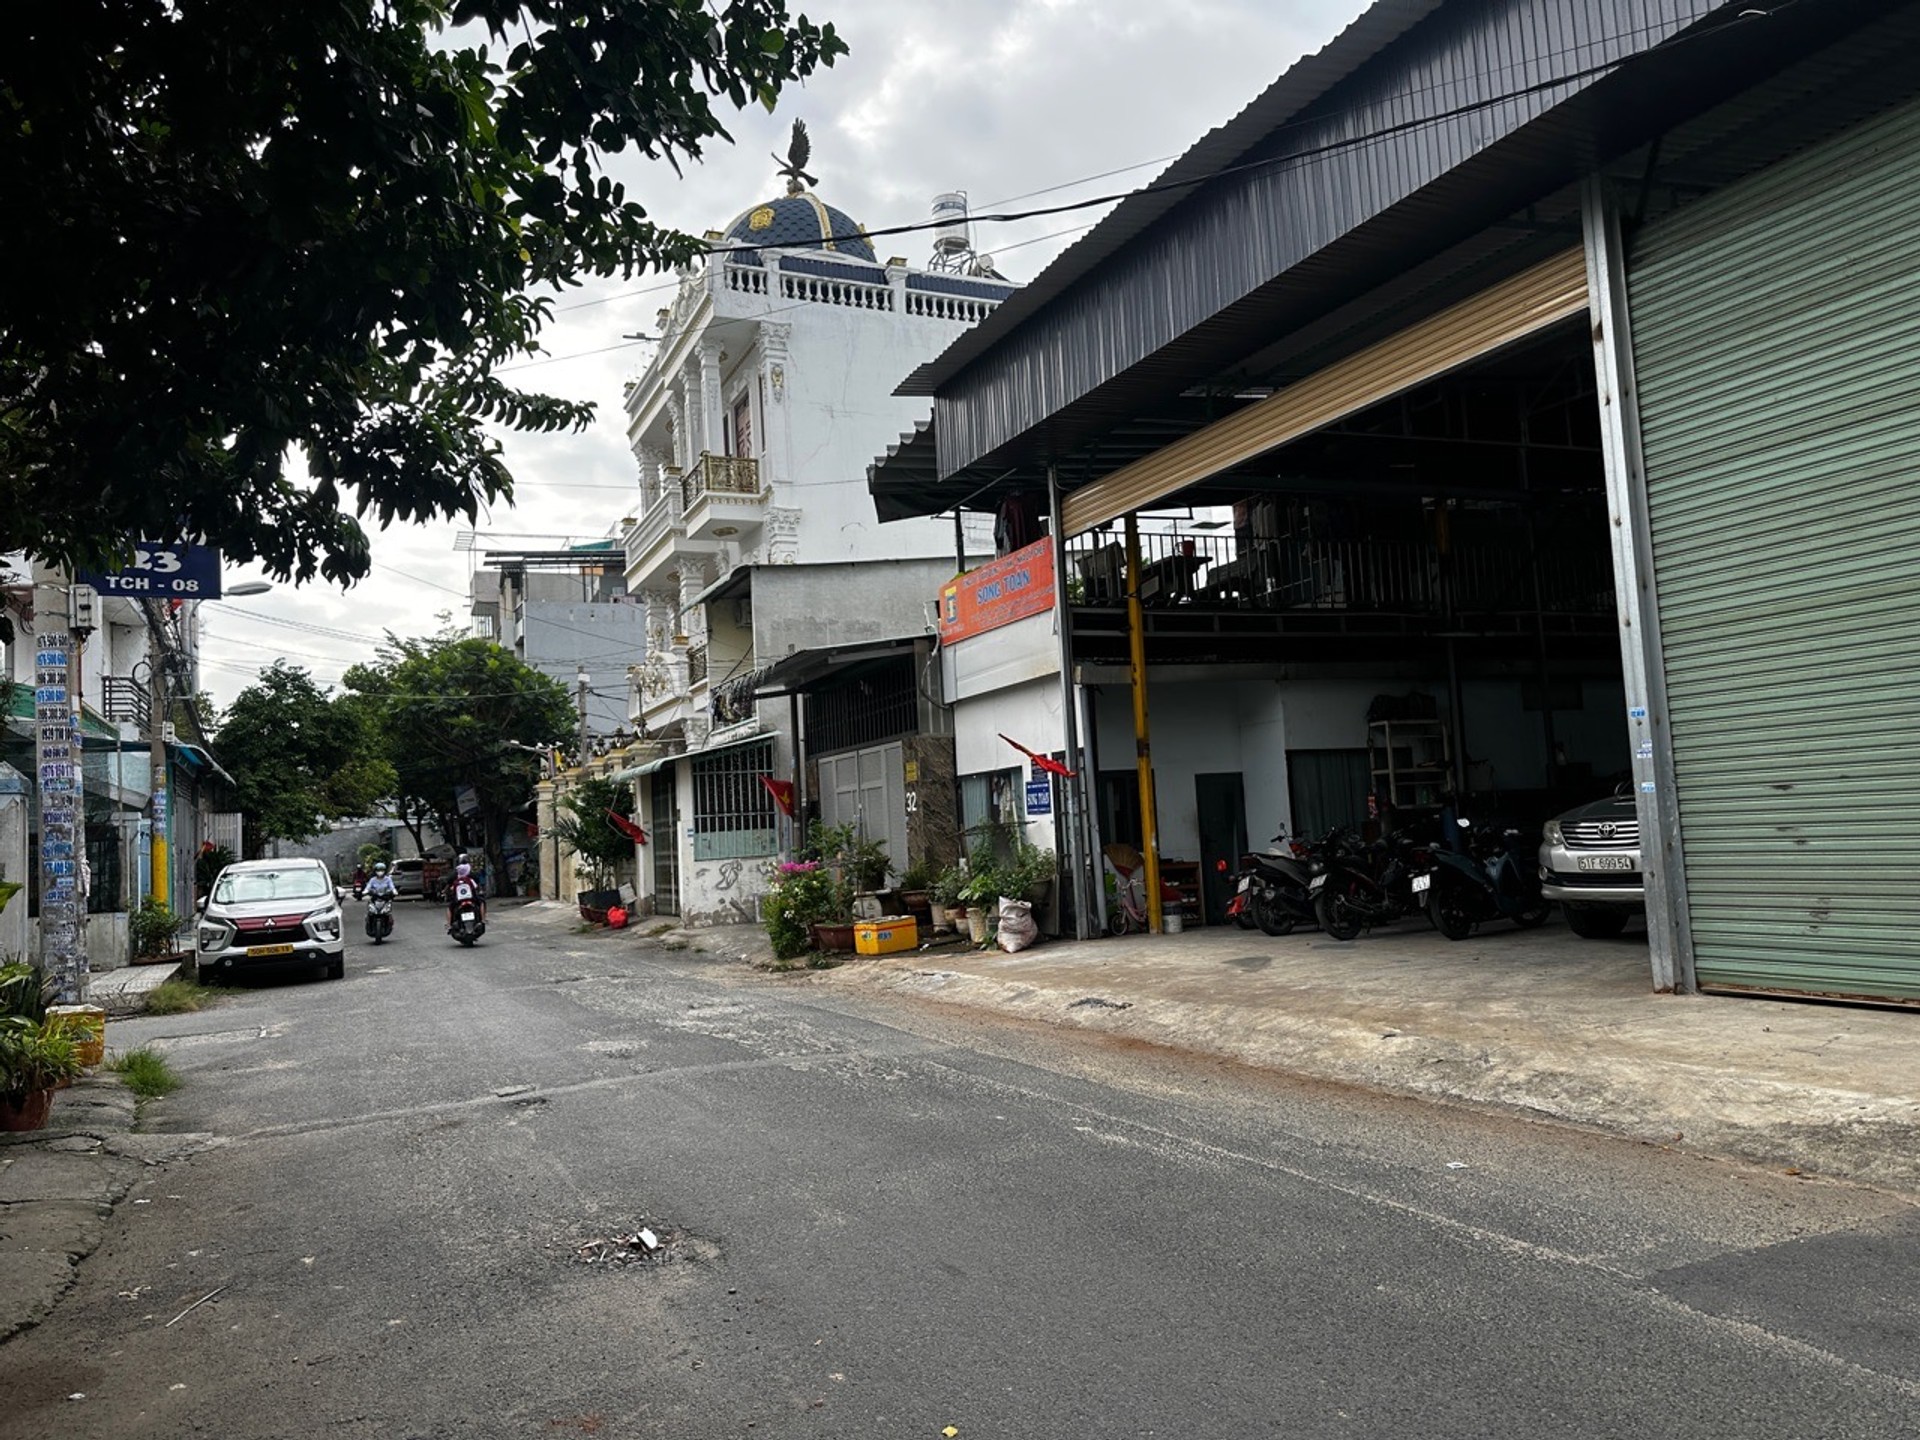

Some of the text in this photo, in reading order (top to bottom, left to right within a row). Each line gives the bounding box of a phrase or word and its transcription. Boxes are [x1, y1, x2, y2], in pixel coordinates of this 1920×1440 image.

[105, 576, 149, 590] TCH
[171, 579, 199, 592] 08
[906, 791, 917, 812] 32
